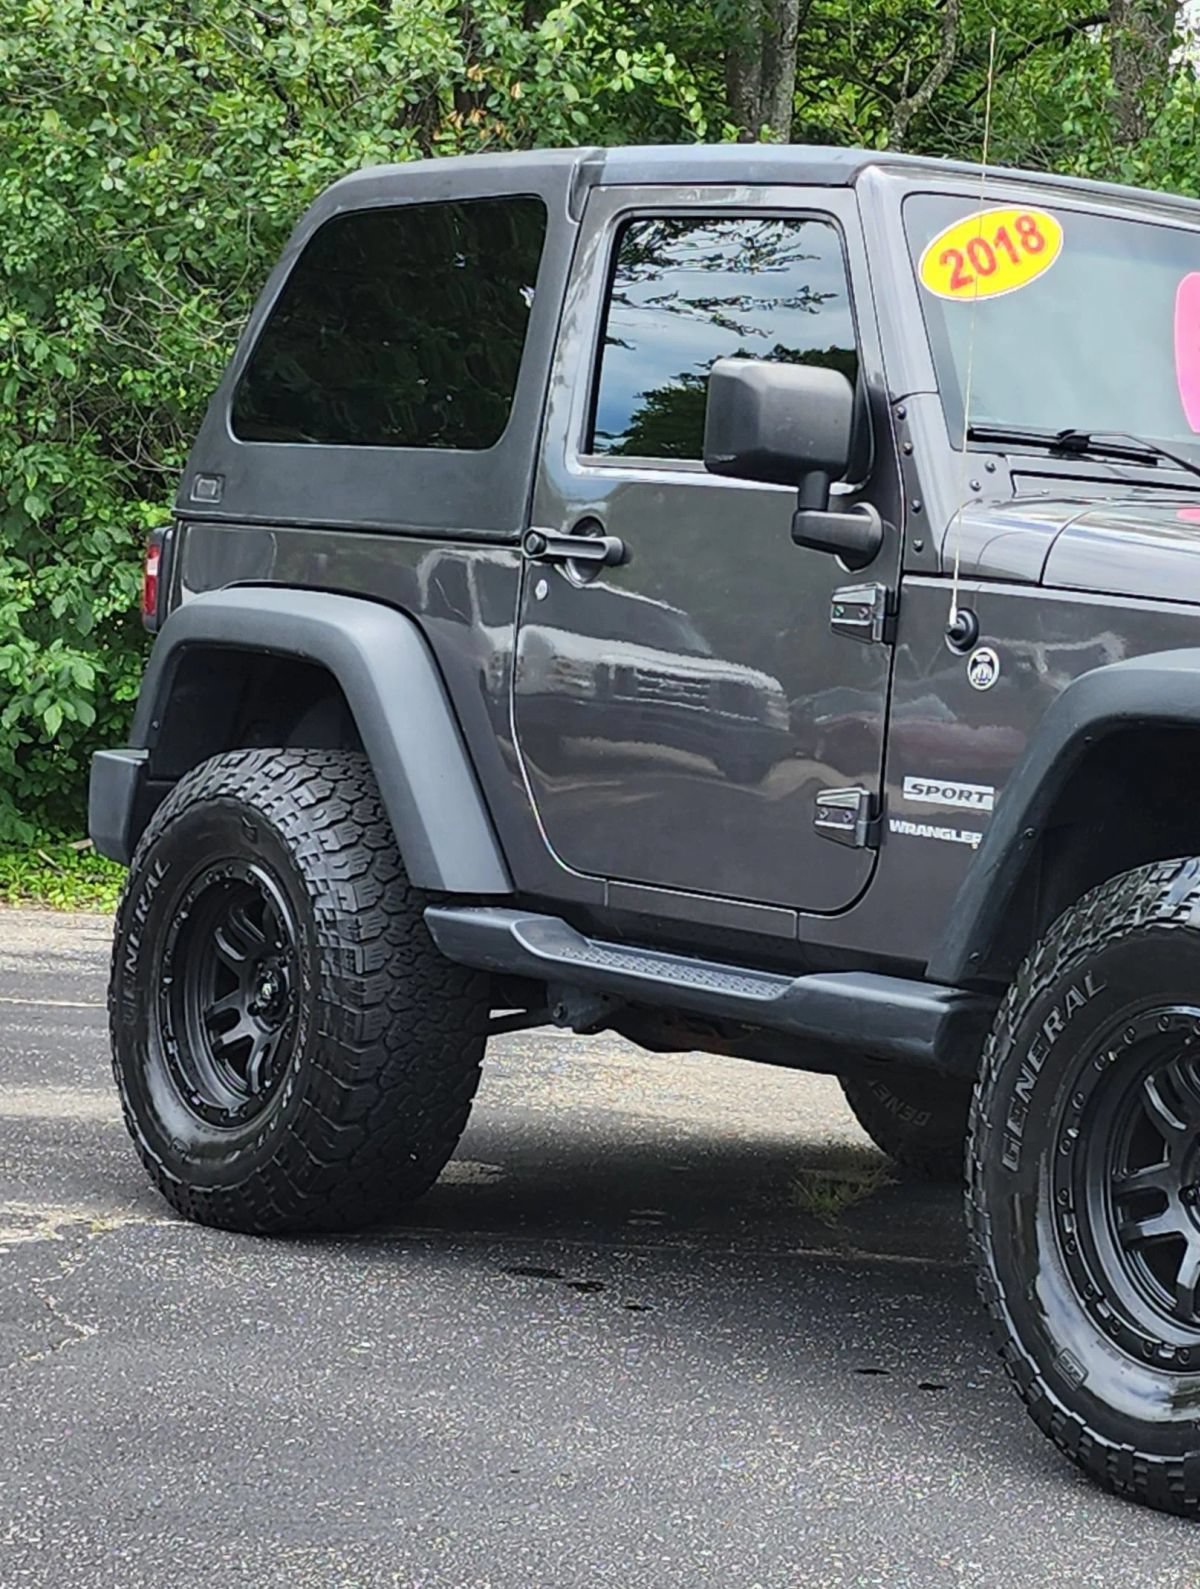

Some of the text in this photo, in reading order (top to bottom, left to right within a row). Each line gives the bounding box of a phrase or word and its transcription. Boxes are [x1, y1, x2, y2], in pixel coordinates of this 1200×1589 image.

[939, 214, 1045, 291] 2018
[908, 782, 991, 804] SPORT
[889, 818, 983, 847] WRANGLER
[1002, 970, 1107, 1172] GENERAL
